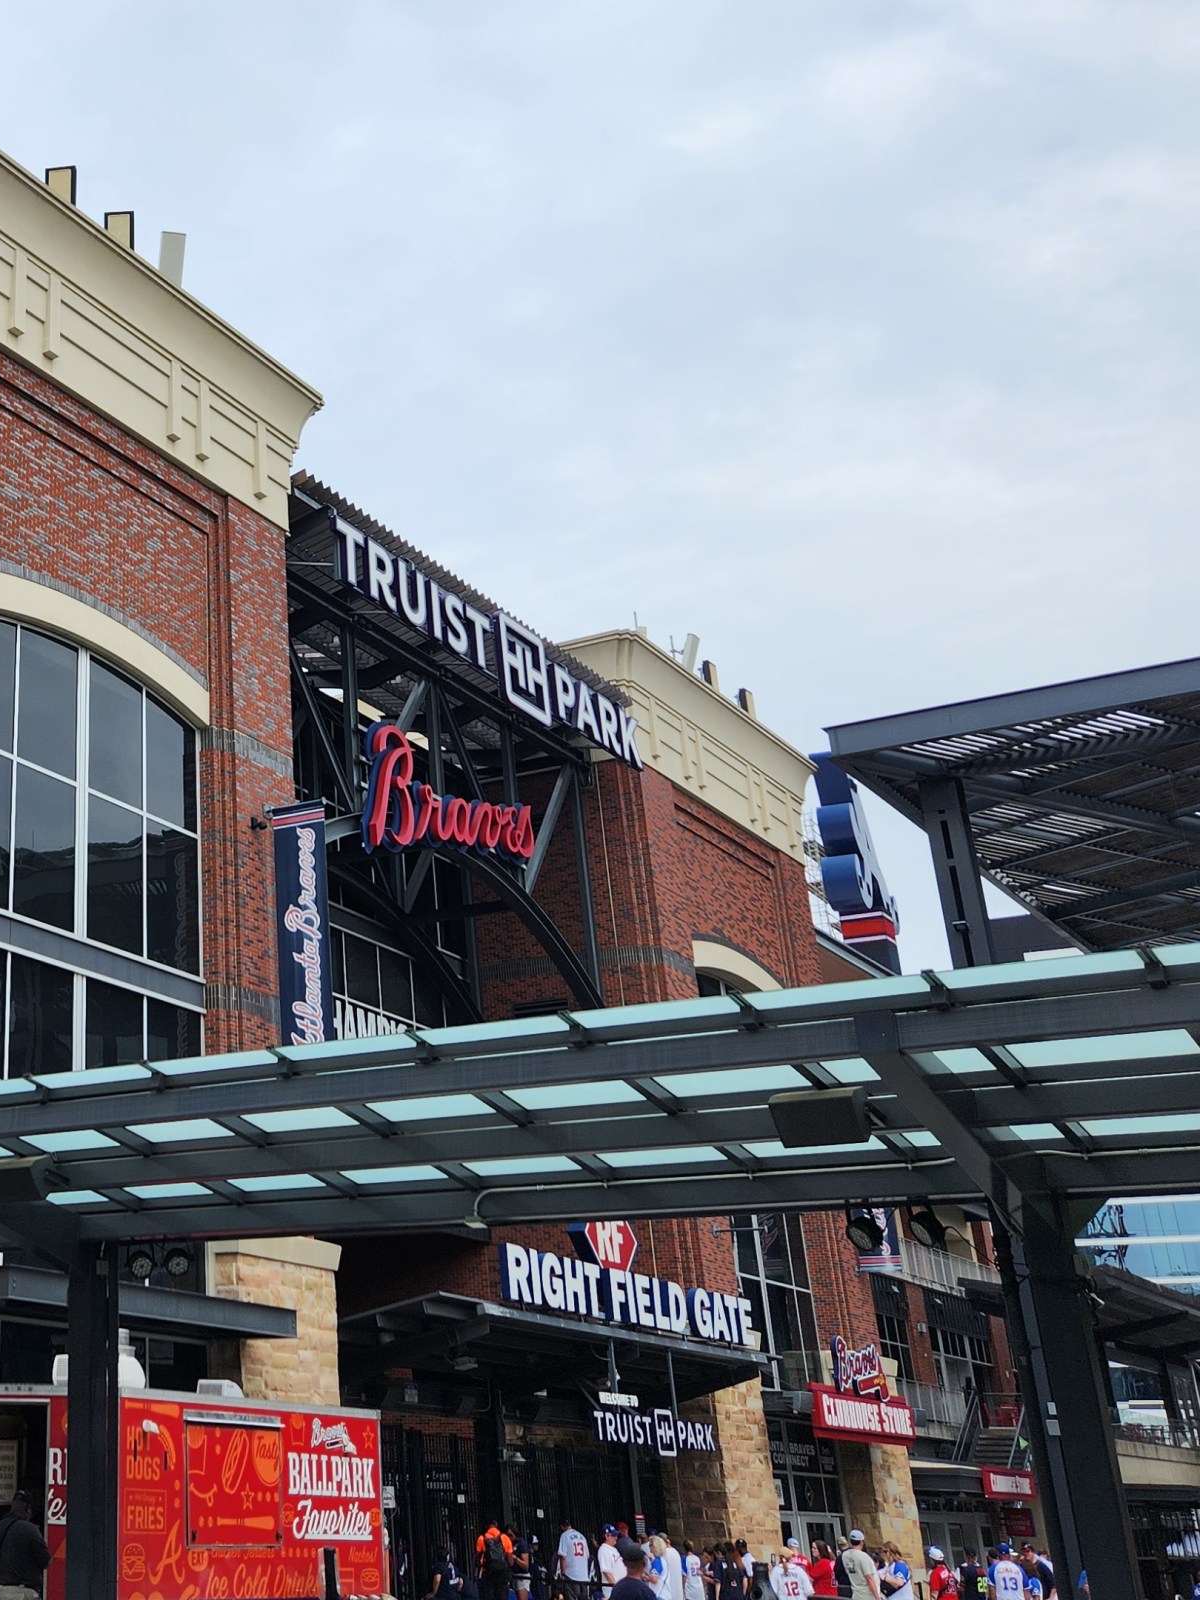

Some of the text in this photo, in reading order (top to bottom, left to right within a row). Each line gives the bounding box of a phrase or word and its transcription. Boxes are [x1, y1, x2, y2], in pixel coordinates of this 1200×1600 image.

[335, 514, 643, 771] TRUIST PARK
[363, 721, 536, 862] Braves
[284, 827, 322, 939] Braves
[596, 1221, 624, 1264] RF
[505, 1242, 756, 1346] RIGHT FIELD GATE
[832, 1335, 877, 1392] Braves
[311, 1417, 346, 1448] Braves
[593, 1410, 716, 1451] TRUIST PARK
[822, 1393, 914, 1436] CLUBHOUSE STORE
[126, 1455, 161, 1481] DOGS
[256, 1434, 280, 1471] Tasty
[287, 1452, 376, 1499] BALLPARK
[126, 1505, 164, 1530] FRIES
[292, 1498, 373, 1540] Favorites
[573, 1542, 585, 1557] 13
[205, 1564, 229, 1599] Ice
[233, 1563, 272, 1599] Cold
[784, 1581, 800, 1597] 12
[1002, 1576, 1019, 1591] 13
